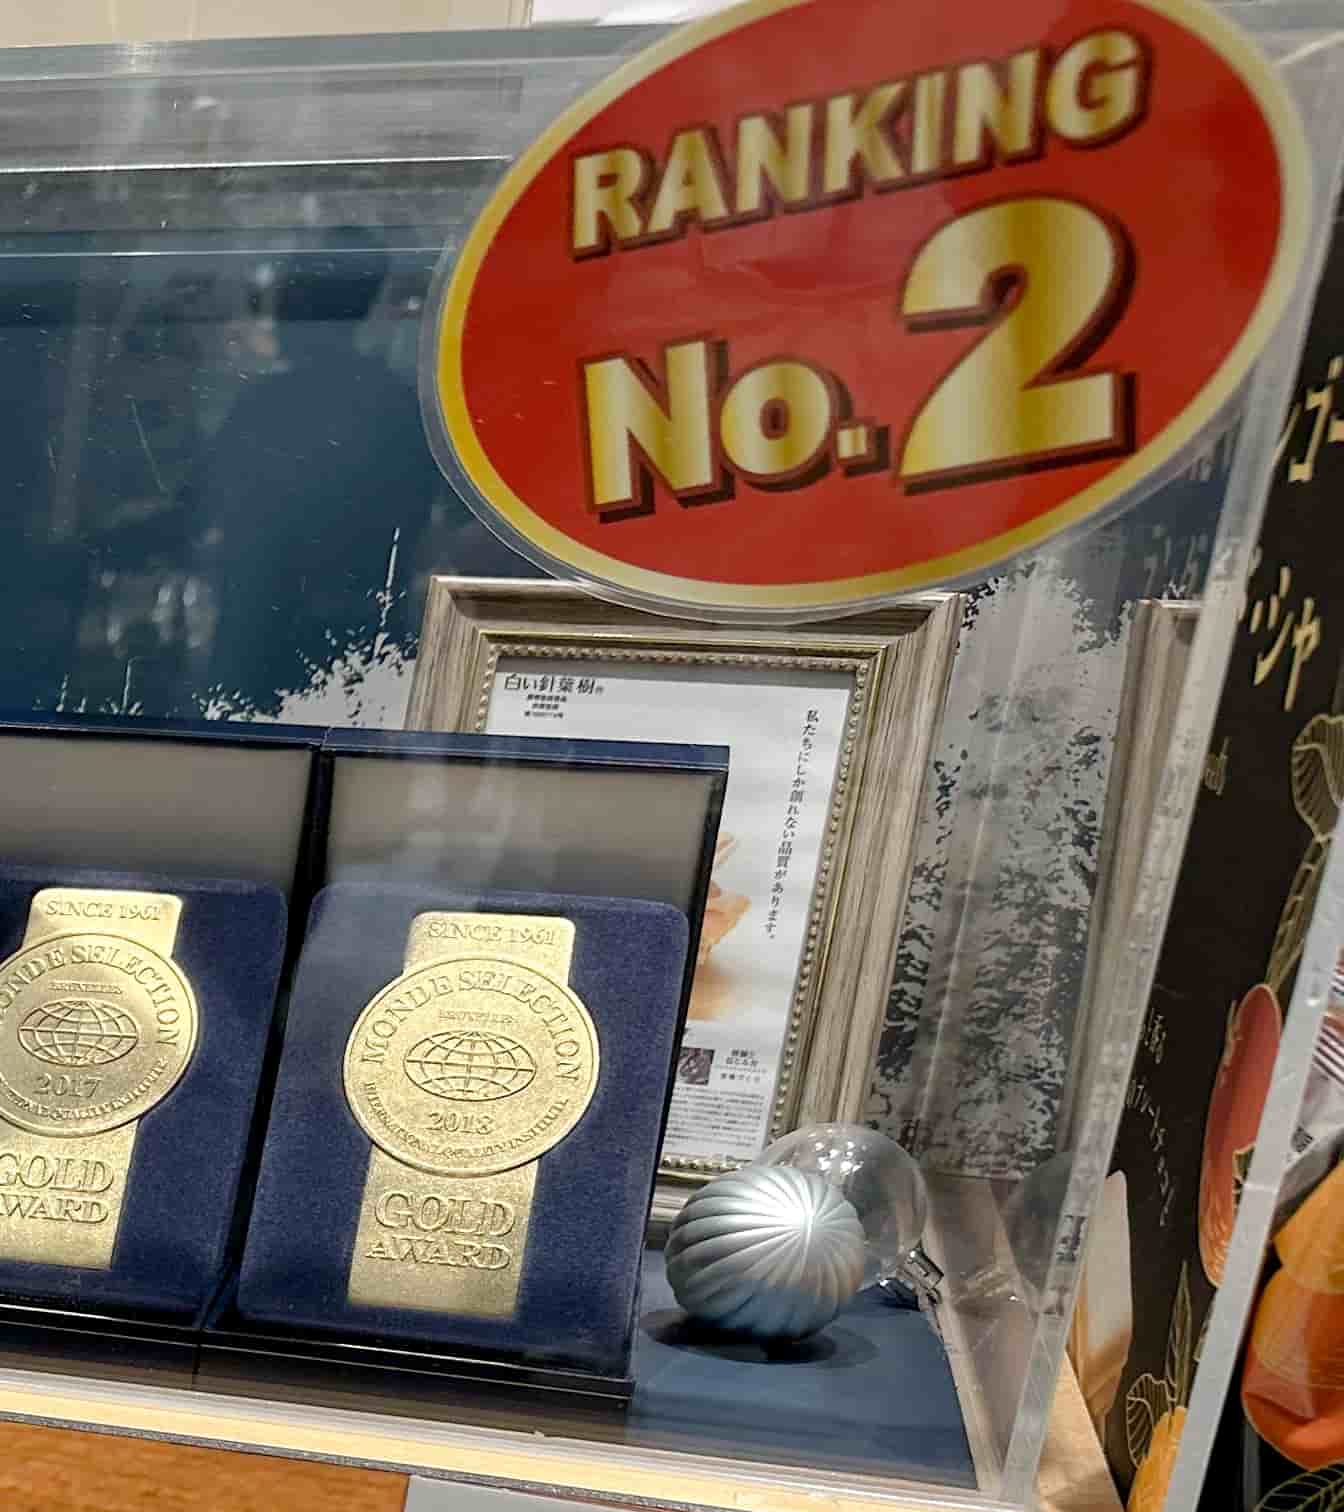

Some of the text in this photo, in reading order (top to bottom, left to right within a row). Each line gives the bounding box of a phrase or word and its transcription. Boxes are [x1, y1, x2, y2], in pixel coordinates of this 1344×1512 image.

[570, 28, 1149, 258] RANKING
[45, 899, 114, 919] SINCE
[426, 918, 556, 946] SINCE 1961
[69, 943, 182, 1048] SELECTION
[360, 968, 582, 1083] MONDE SELECTION
[32, 1071, 104, 1098] 2017
[373, 1190, 517, 1238] GOLD
[365, 1234, 512, 1271] AWARD
